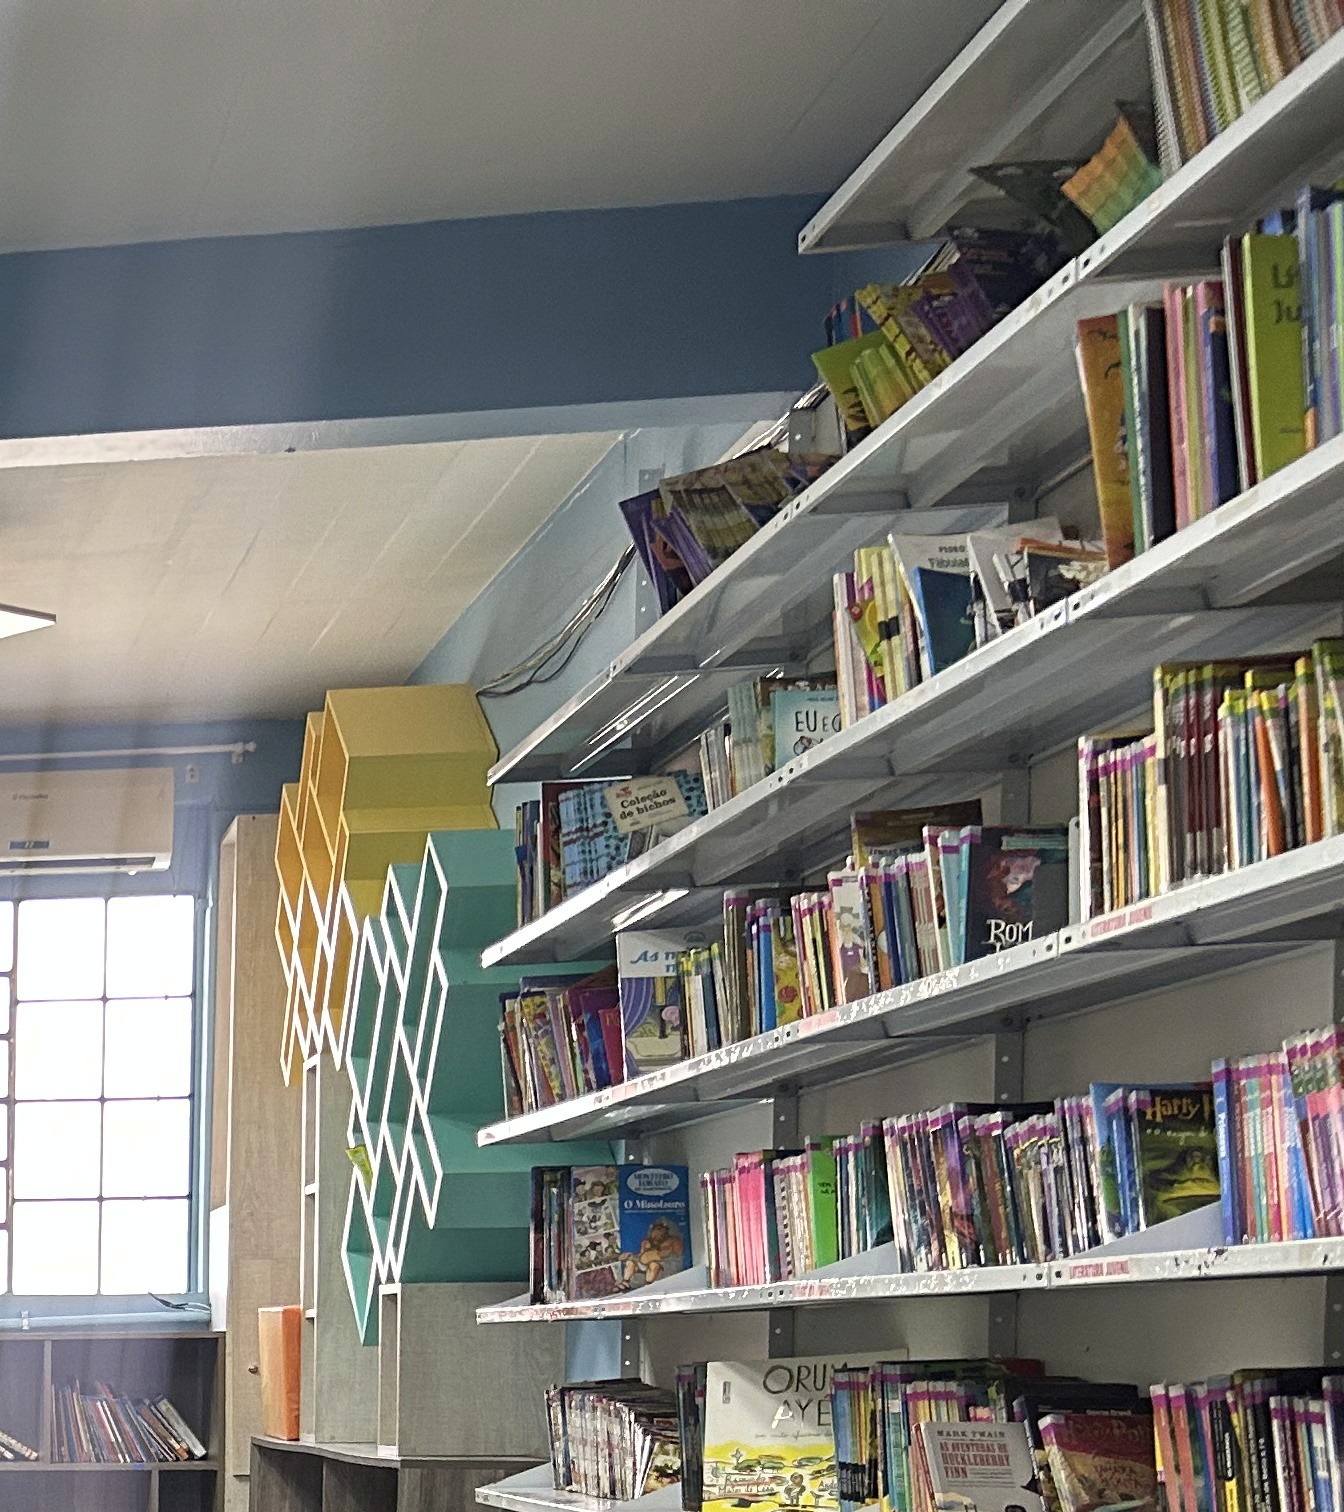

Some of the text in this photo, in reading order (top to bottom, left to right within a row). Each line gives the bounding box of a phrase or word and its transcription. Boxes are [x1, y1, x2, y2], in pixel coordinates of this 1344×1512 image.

[794, 710, 818, 733] EU
[620, 788, 668, 809] Coleção
[619, 797, 677, 820] de bichos
[1145, 1096, 1201, 1122] Harry
[624, 1200, 686, 1209] O Minotauro
[937, 1430, 1006, 1438] MARK TWAIN
[952, 1442, 995, 1453] AVENTURAS
[942, 1453, 1010, 1467] HUCKLEBERRY
[945, 1466, 969, 1479] FINN
